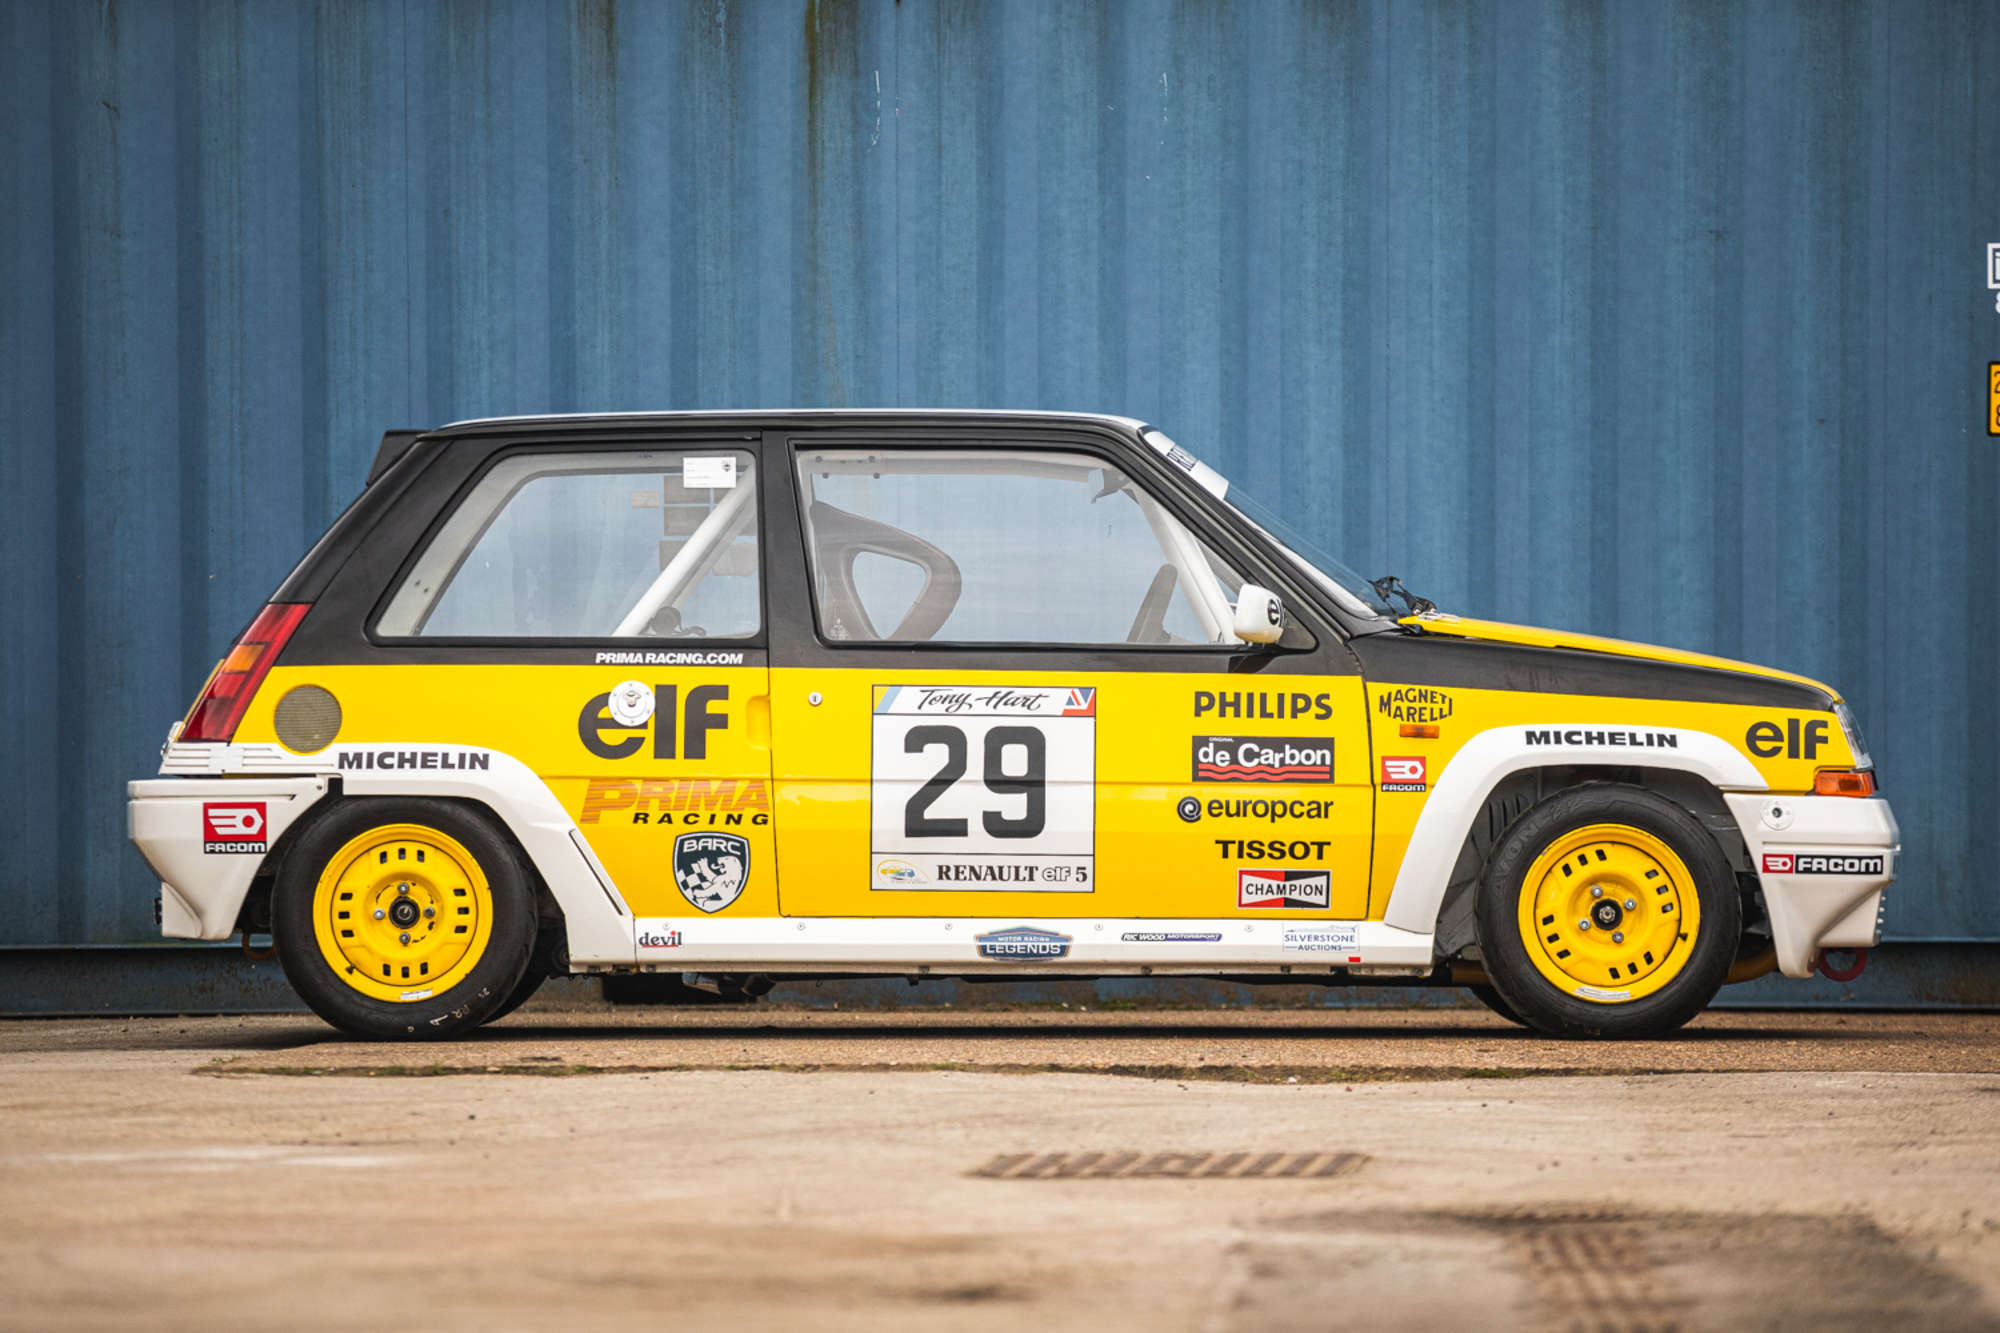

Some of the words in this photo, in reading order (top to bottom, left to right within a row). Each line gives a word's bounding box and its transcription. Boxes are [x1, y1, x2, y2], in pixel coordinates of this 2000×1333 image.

[917, 689, 973, 713] Tony
[975, 690, 1050, 711] Hart
[1194, 691, 1333, 720] PHILIPS
[578, 684, 729, 760] elf
[1525, 730, 1678, 748] MICHELIN
[1746, 718, 1828, 760] elf
[338, 752, 489, 770] MICHELIN
[1198, 743, 1231, 767] de
[1237, 743, 1331, 768] Carbon
[904, 725, 1046, 838] 29
[1382, 784, 1425, 792] FACOM
[579, 779, 769, 825] PRIMA
[1207, 799, 1334, 823] europcar
[632, 812, 769, 825] RACING
[205, 842, 265, 852] FACOM
[683, 837, 741, 855] BARC
[1215, 840, 1331, 860] TISSOT
[937, 865, 1038, 882] RENAULT
[1042, 866, 1071, 882] elf
[1075, 867, 1088, 882] 5
[1798, 857, 1883, 873] FACOM
[1245, 883, 1324, 896] CHAMPION
[638, 930, 683, 947] devil
[1284, 934, 1356, 943] SILVERSTONE
[986, 943, 1061, 954] LEGENDS
[1298, 944, 1342, 952] AUCTIONS
